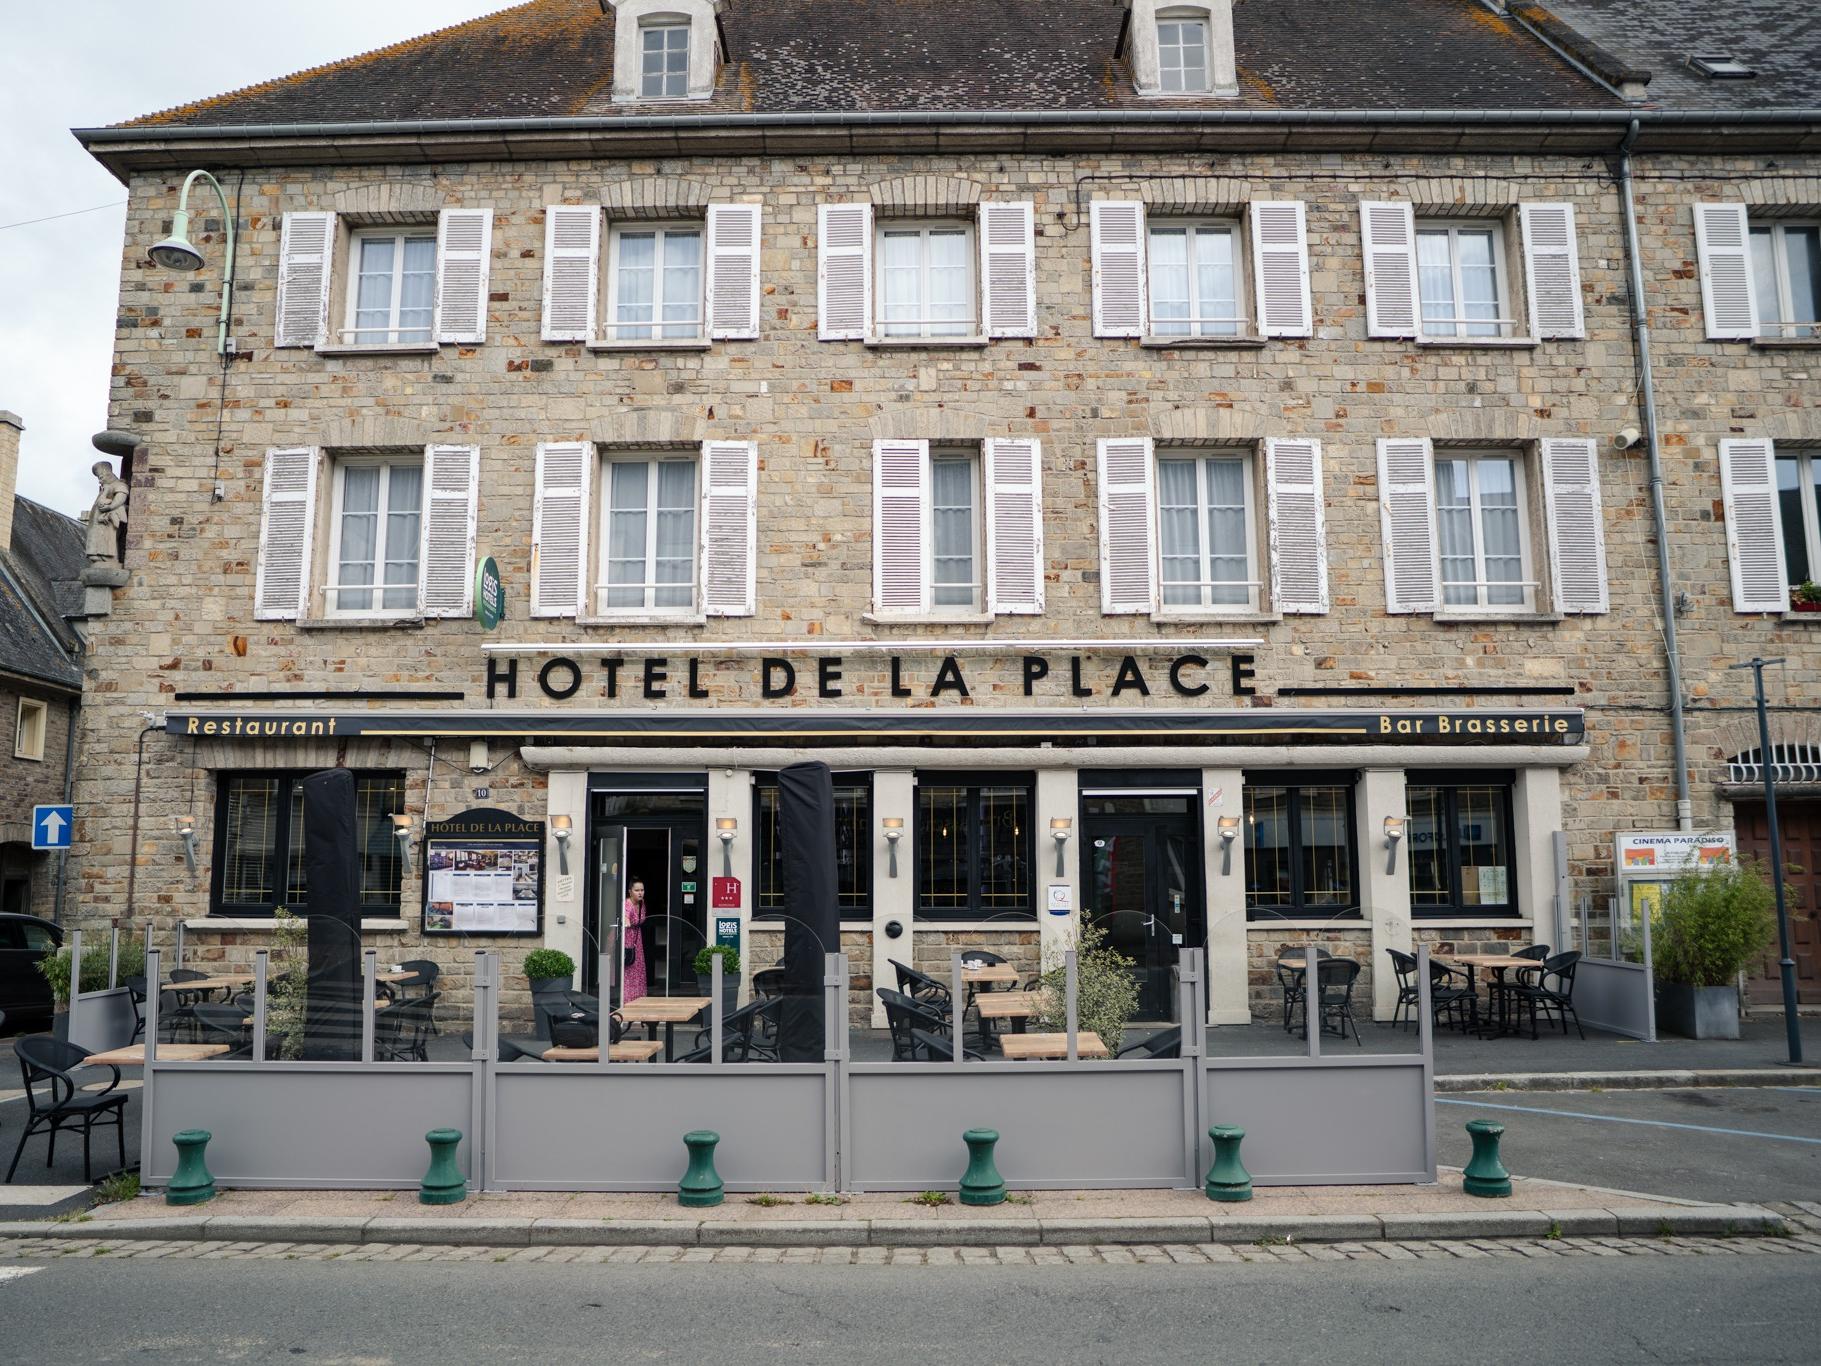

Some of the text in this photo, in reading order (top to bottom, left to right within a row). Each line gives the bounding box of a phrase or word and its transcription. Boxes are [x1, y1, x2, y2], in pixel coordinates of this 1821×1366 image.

[486, 654, 1257, 699] HOTEL DE LA PLACE
[187, 717, 337, 735] Restaurant
[1380, 714, 1569, 734] Bar Brasserie
[478, 789, 487, 797] 10
[431, 822, 540, 832] HÔTEL DE LA PLACE
[1633, 837, 1725, 845] CINEMA PARADISO
[726, 882, 737, 894] H
